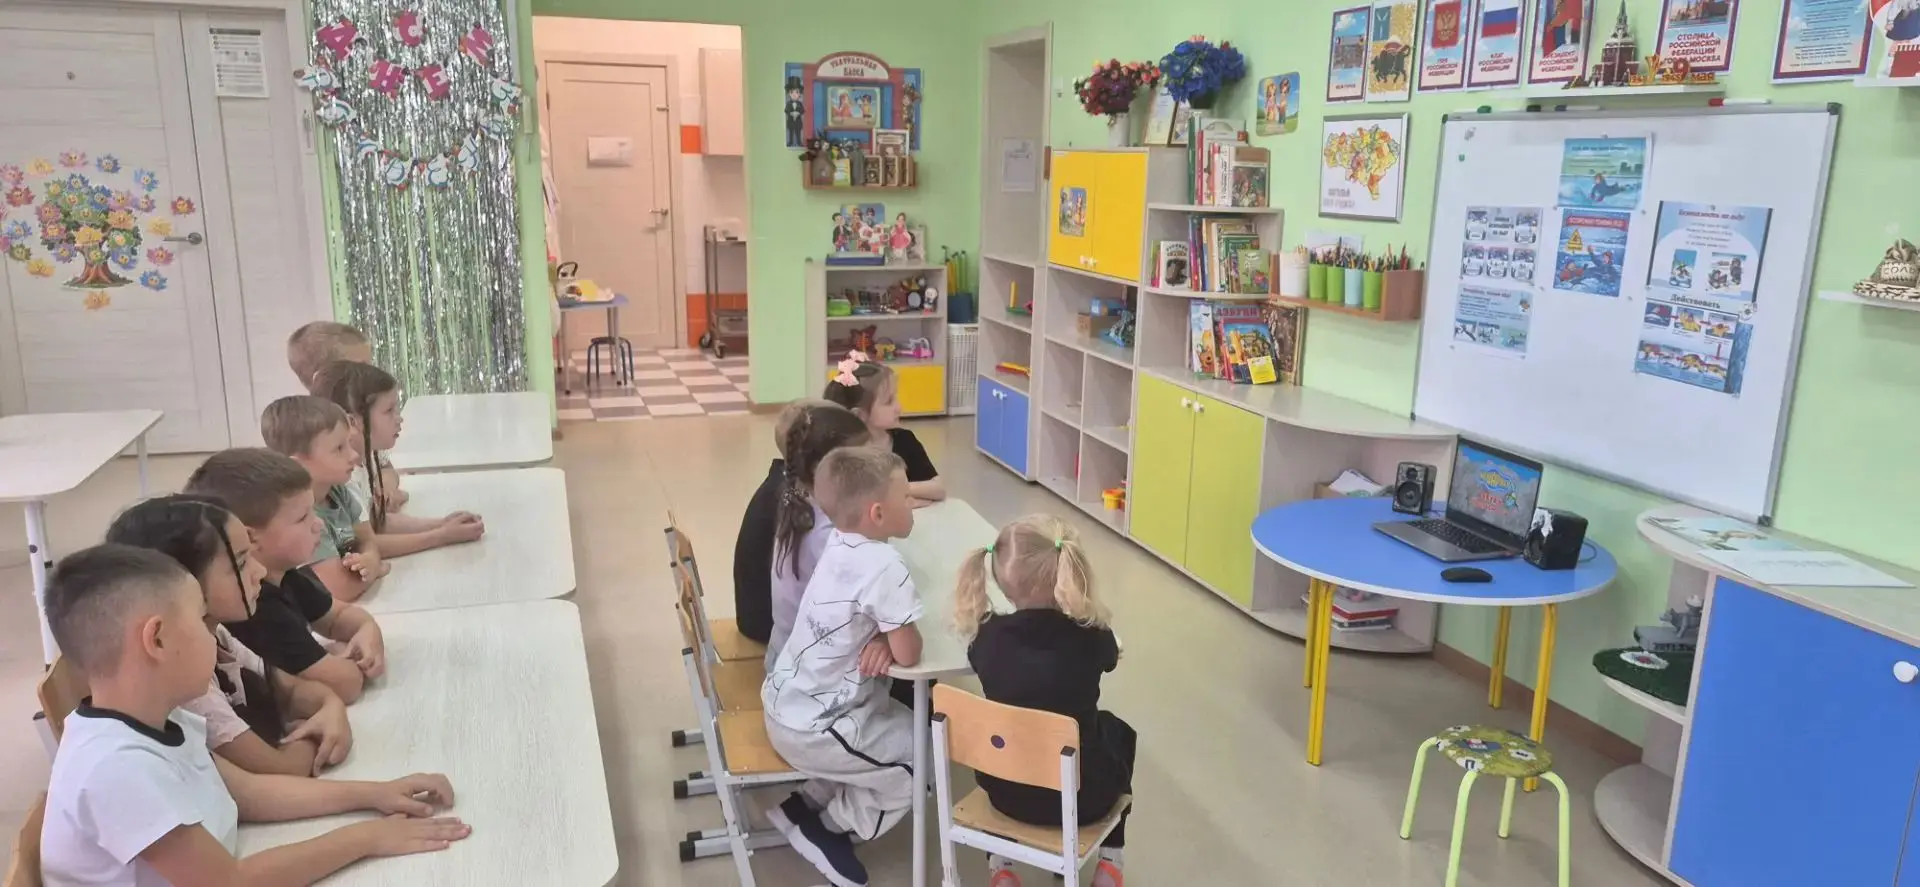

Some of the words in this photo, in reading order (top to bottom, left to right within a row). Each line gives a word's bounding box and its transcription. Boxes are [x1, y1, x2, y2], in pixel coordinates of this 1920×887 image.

[1677, 32, 1715, 41] СТОЛИЦА
[1669, 39, 1721, 49] РОССИЙСКОЙ
[1671, 48, 1716, 57] ФЕДЕРАЦИИ
[1670, 293, 1720, 309] Действовать
